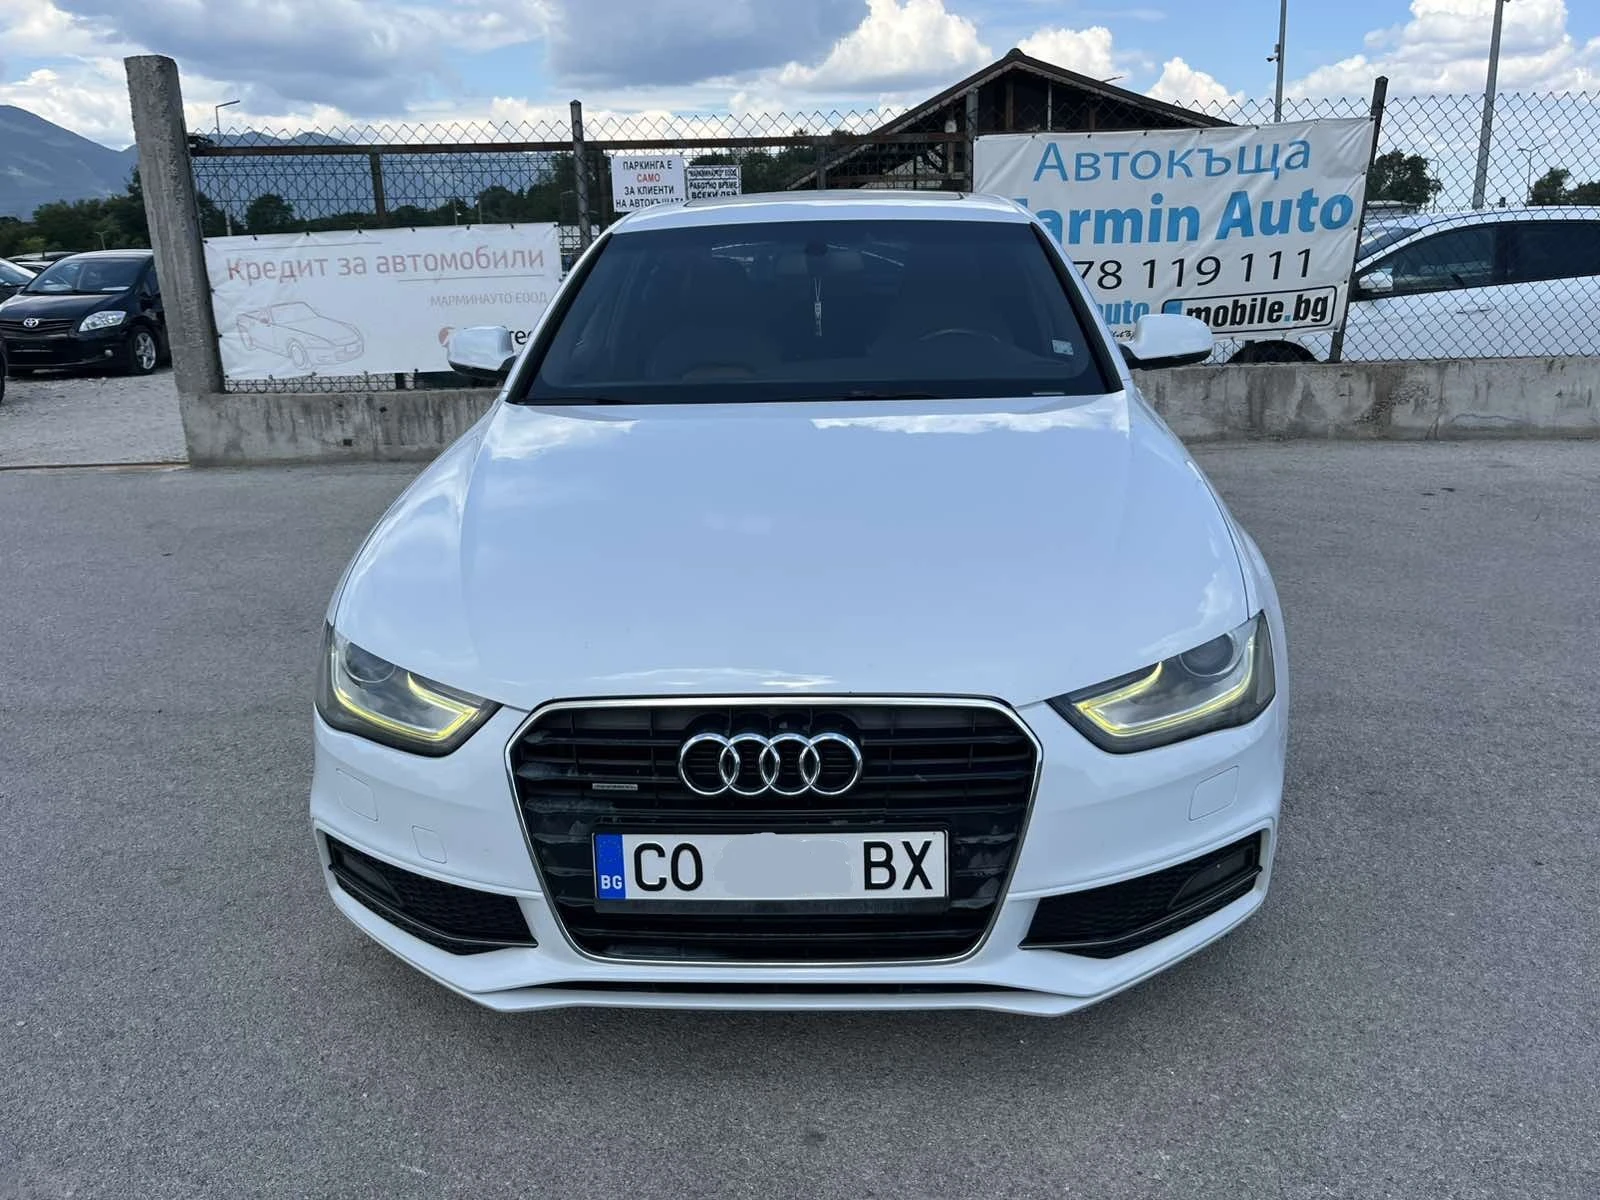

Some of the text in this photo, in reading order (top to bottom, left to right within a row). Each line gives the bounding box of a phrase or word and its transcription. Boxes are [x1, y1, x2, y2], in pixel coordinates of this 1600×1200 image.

[623, 160, 673, 170] ПАРКИНГА Е
[1033, 139, 1311, 182] Автокъща
[624, 185, 674, 196] ЗА КЛИЕНТИ
[637, 173, 661, 183] САМО
[615, 199, 627, 208] НА
[1014, 190, 1355, 245] armin Auto
[226, 245, 544, 286] Кредит за автомобили
[1073, 248, 1311, 290] 78 119 111
[1097, 294, 1329, 327] uto mobile.bg
[600, 874, 623, 890] BG
[863, 840, 934, 891] BX
